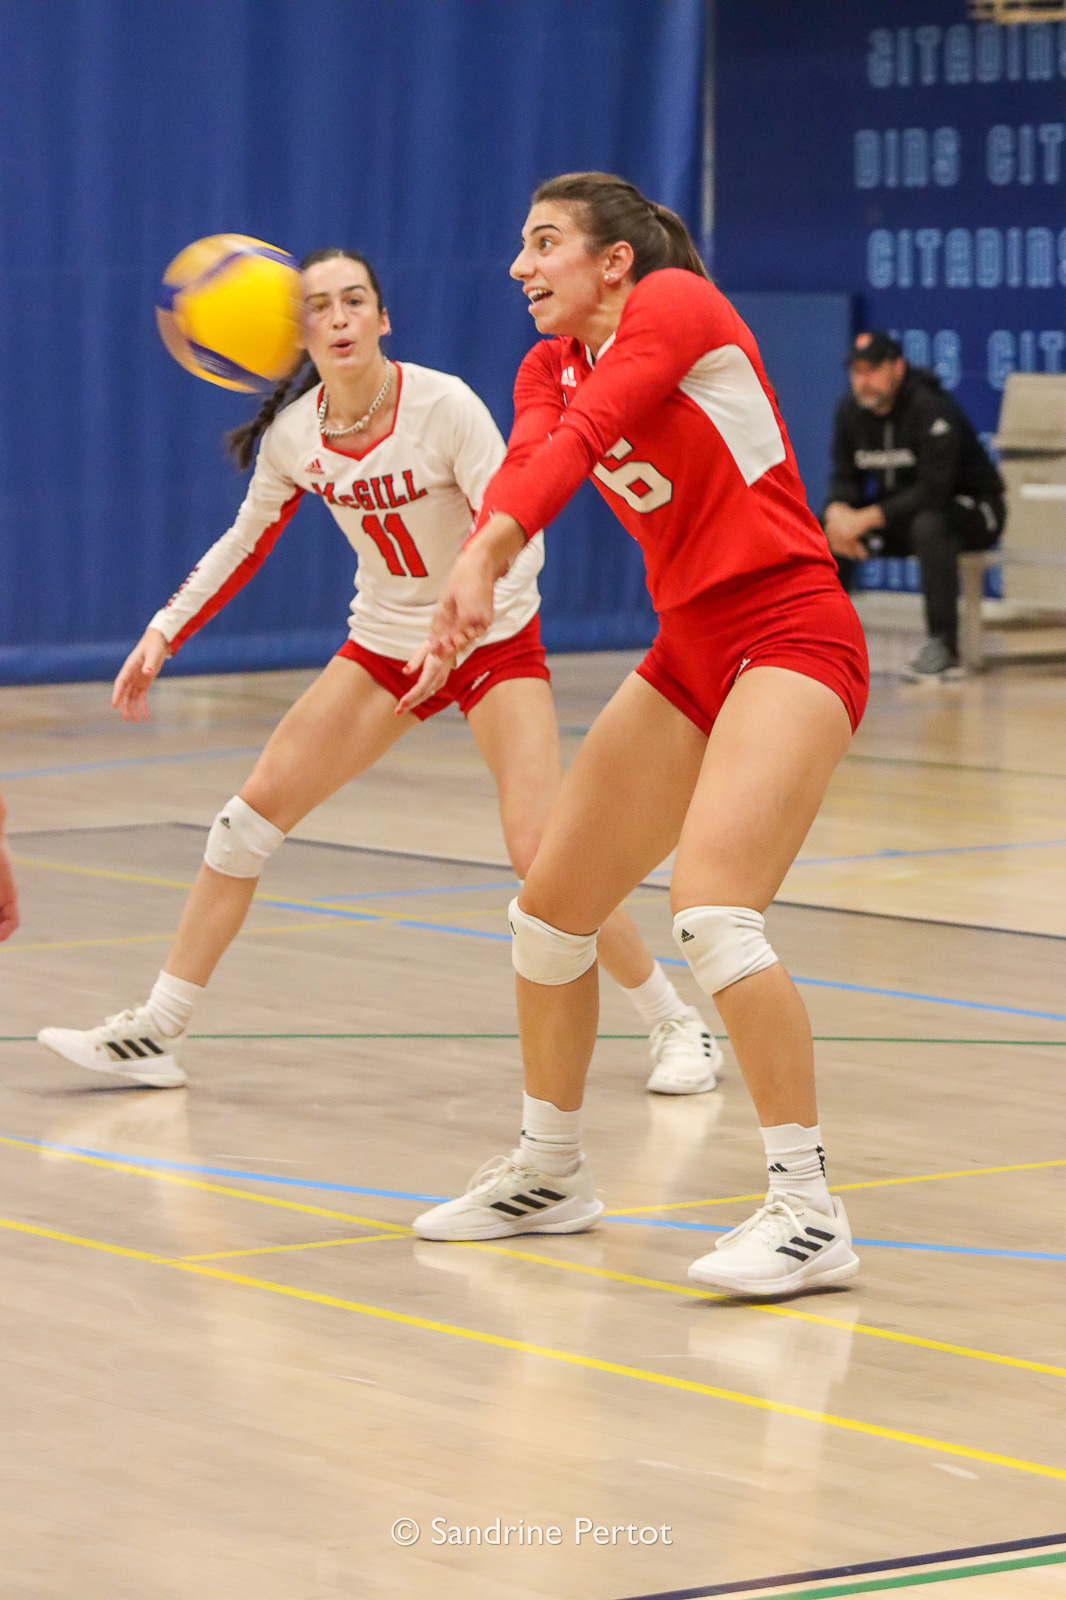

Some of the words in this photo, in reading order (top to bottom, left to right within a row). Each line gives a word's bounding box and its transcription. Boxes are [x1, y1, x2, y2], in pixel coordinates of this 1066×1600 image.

[311, 469, 428, 511] McGILL
[592, 436, 673, 514] 6
[361, 513, 429, 577] 11
